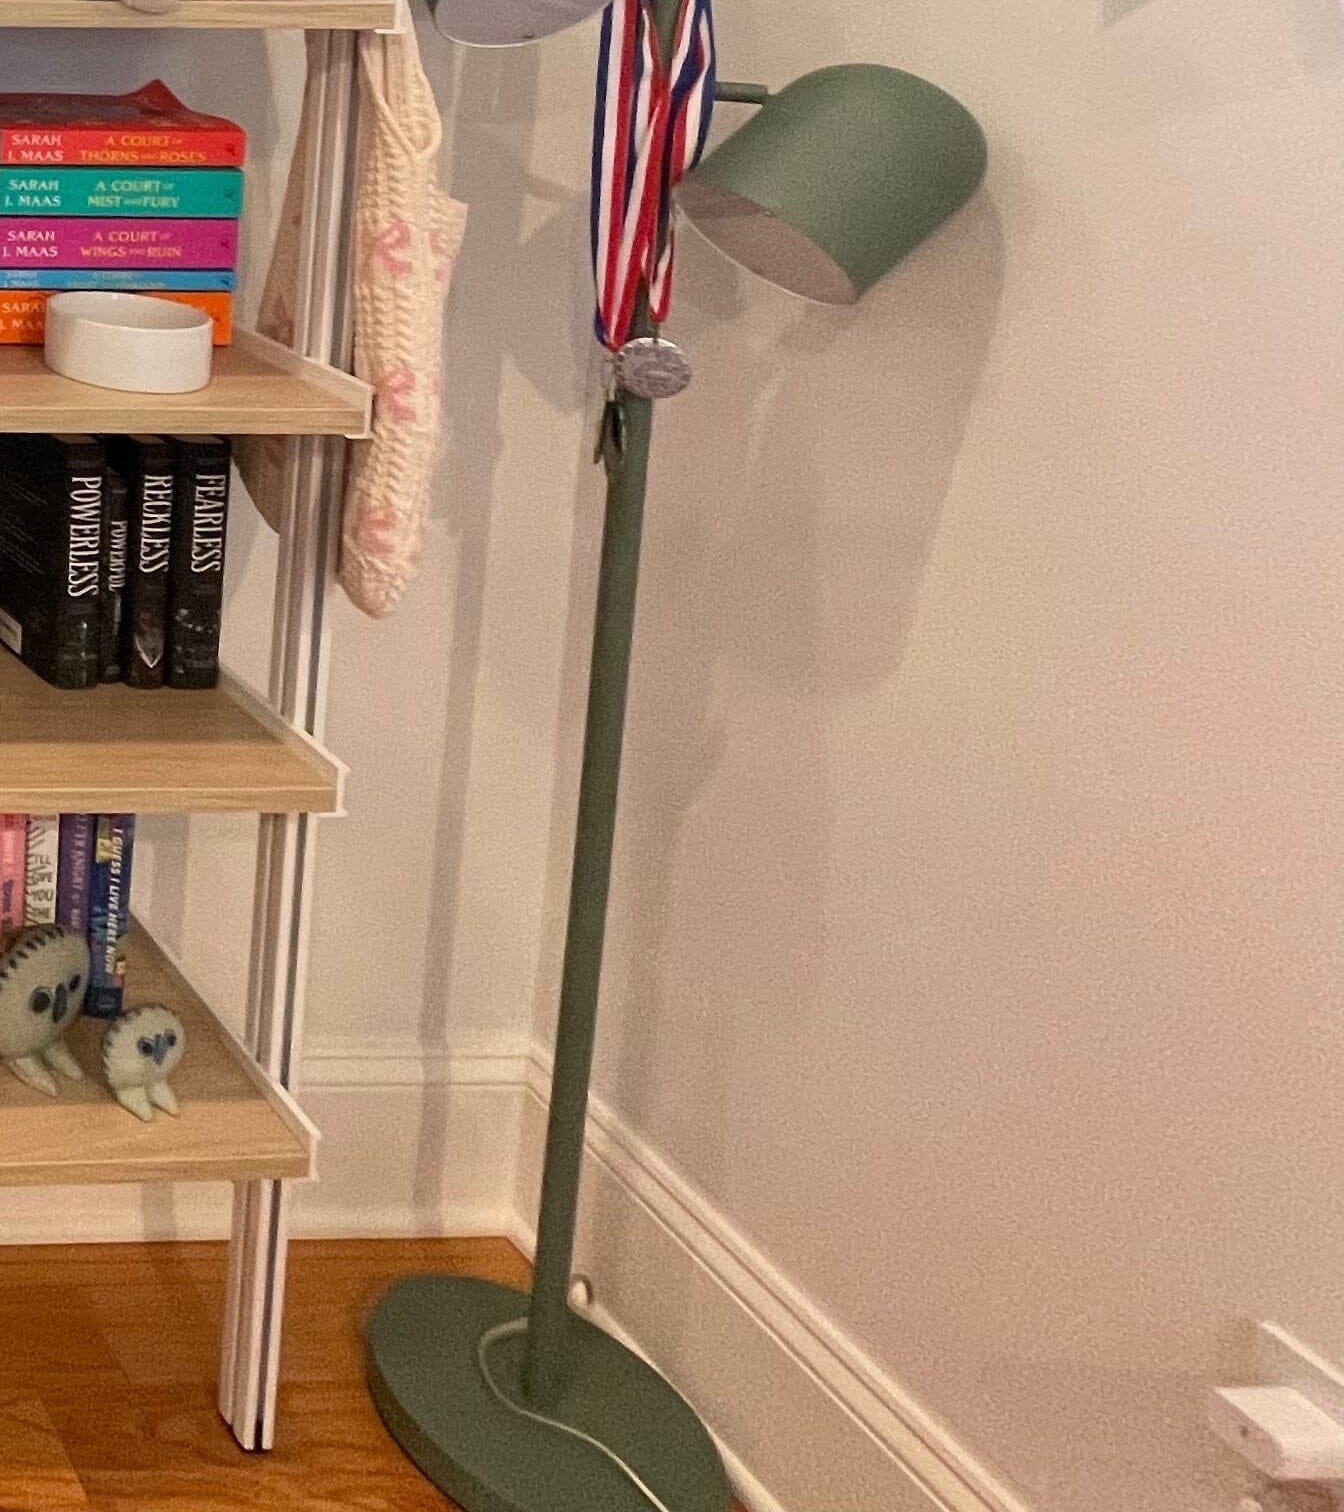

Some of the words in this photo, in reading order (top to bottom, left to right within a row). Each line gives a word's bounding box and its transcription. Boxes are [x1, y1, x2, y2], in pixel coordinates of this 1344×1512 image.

[11, 134, 62, 145] SARAH
[121, 135, 171, 146] COURT
[21, 151, 63, 161] MAAS
[80, 151, 139, 162] THORNS
[159, 151, 207, 162] ROSES
[8, 180, 59, 191] SARAH
[111, 181, 160, 192] COURT
[19, 196, 61, 207] MAAS
[87, 196, 121, 207] MIST
[142, 196, 179, 208] FURY
[7, 231, 55, 241] SARAH
[108, 231, 157, 242] COURT
[16, 246, 58, 257] MAAS
[80, 247, 127, 258] WINGS
[147, 247, 182, 258] RUIN
[138, 475, 173, 573] RECKLESS
[190, 473, 226, 573] FEARLESS
[67, 476, 102, 597] POWERLESS
